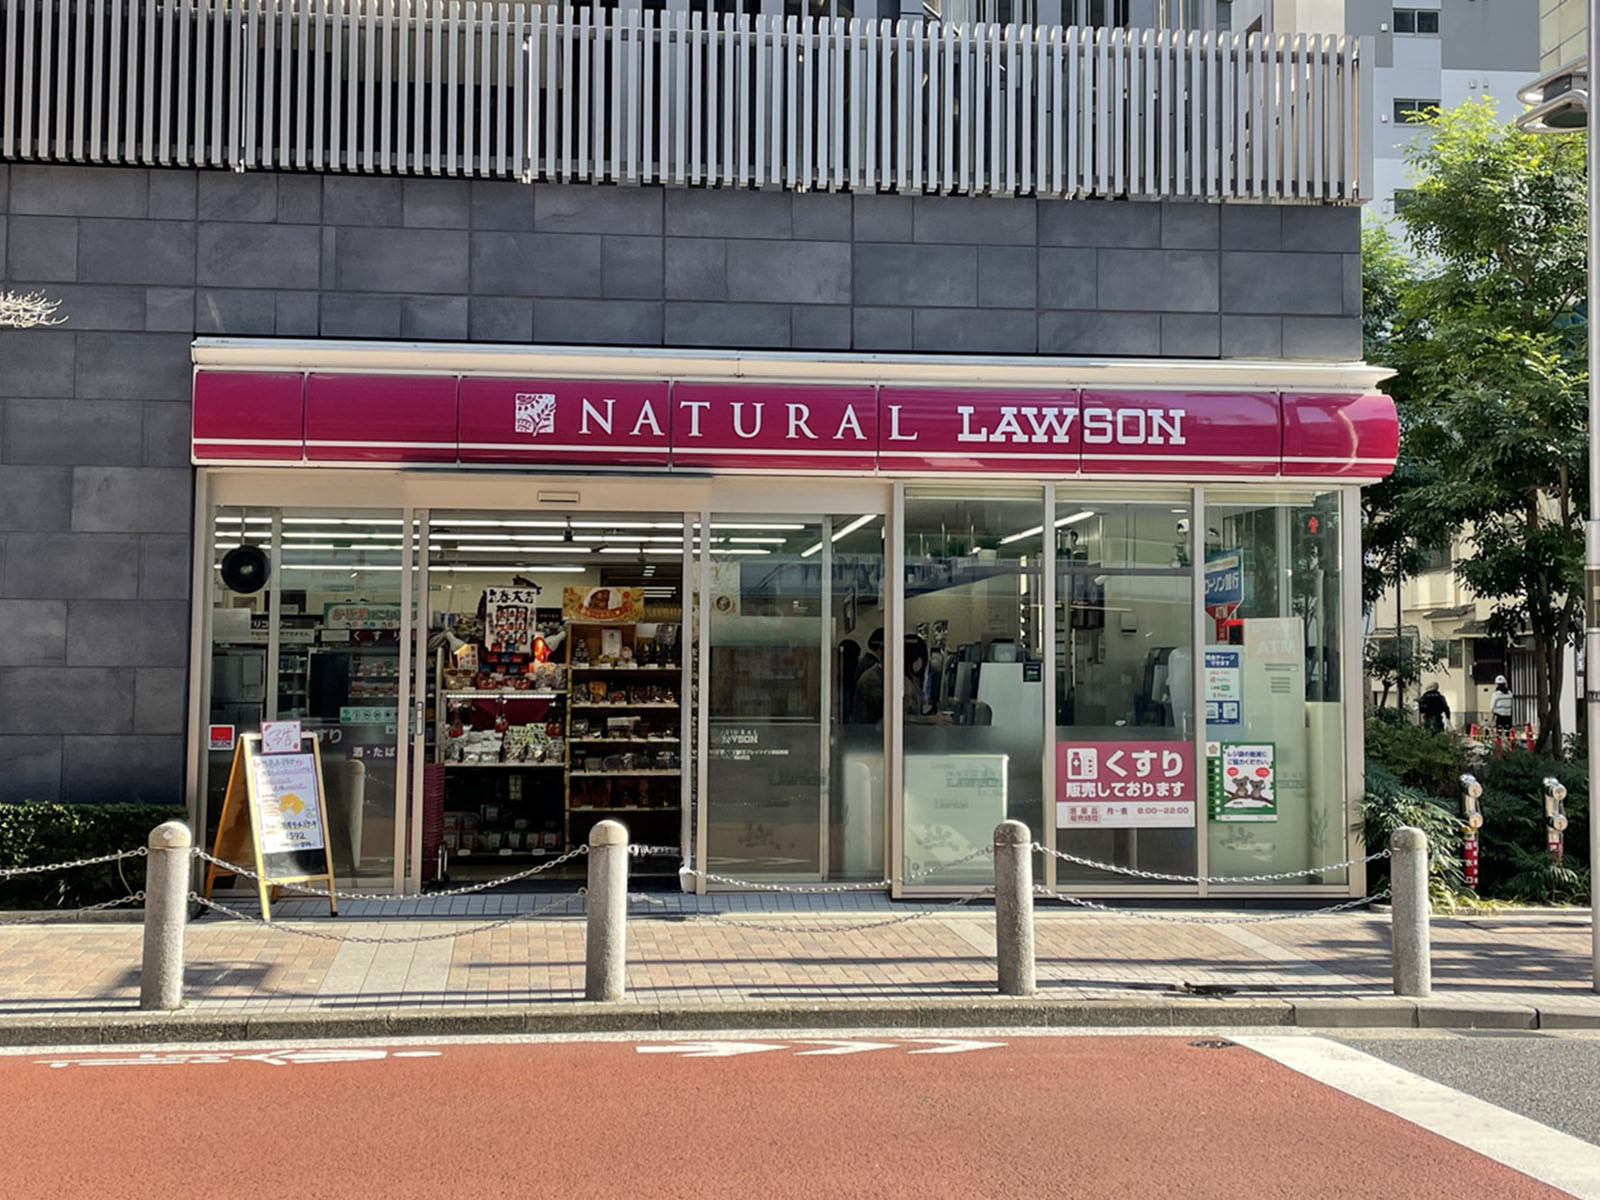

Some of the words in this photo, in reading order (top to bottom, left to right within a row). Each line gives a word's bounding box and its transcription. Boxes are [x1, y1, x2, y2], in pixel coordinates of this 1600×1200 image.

[578, 397, 919, 441] NATURAL
[957, 405, 1187, 445] LAWSON
[1105, 749, 1184, 778] くすり
[1065, 781, 1186, 799] 販売しております
